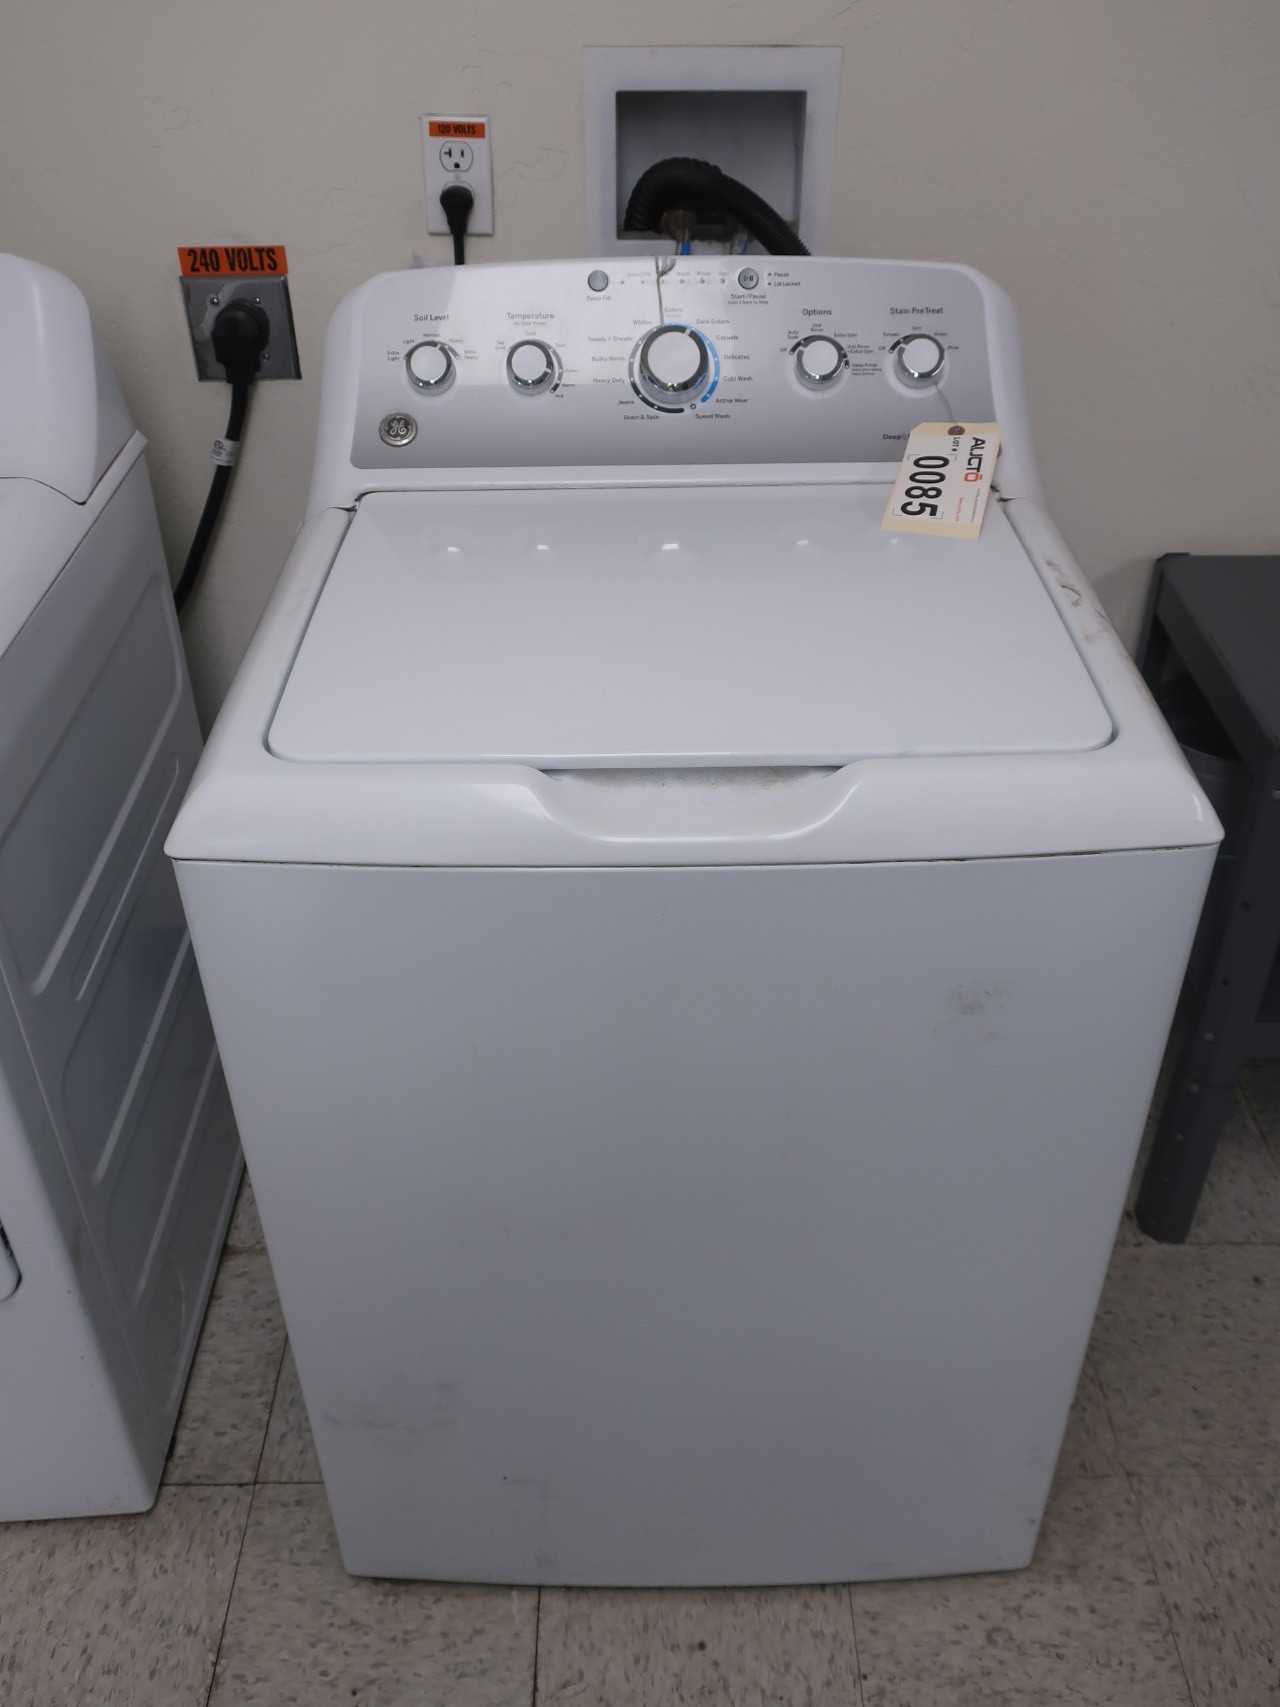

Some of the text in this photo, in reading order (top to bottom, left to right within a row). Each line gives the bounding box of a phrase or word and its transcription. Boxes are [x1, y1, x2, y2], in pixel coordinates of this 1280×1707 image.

[187, 247, 277, 272] 240 VOLTS
[414, 313, 449, 321] Soil Level
[507, 312, 555, 321] Temperature
[802, 308, 832, 317] Options
[900, 455, 950, 517] 0085
